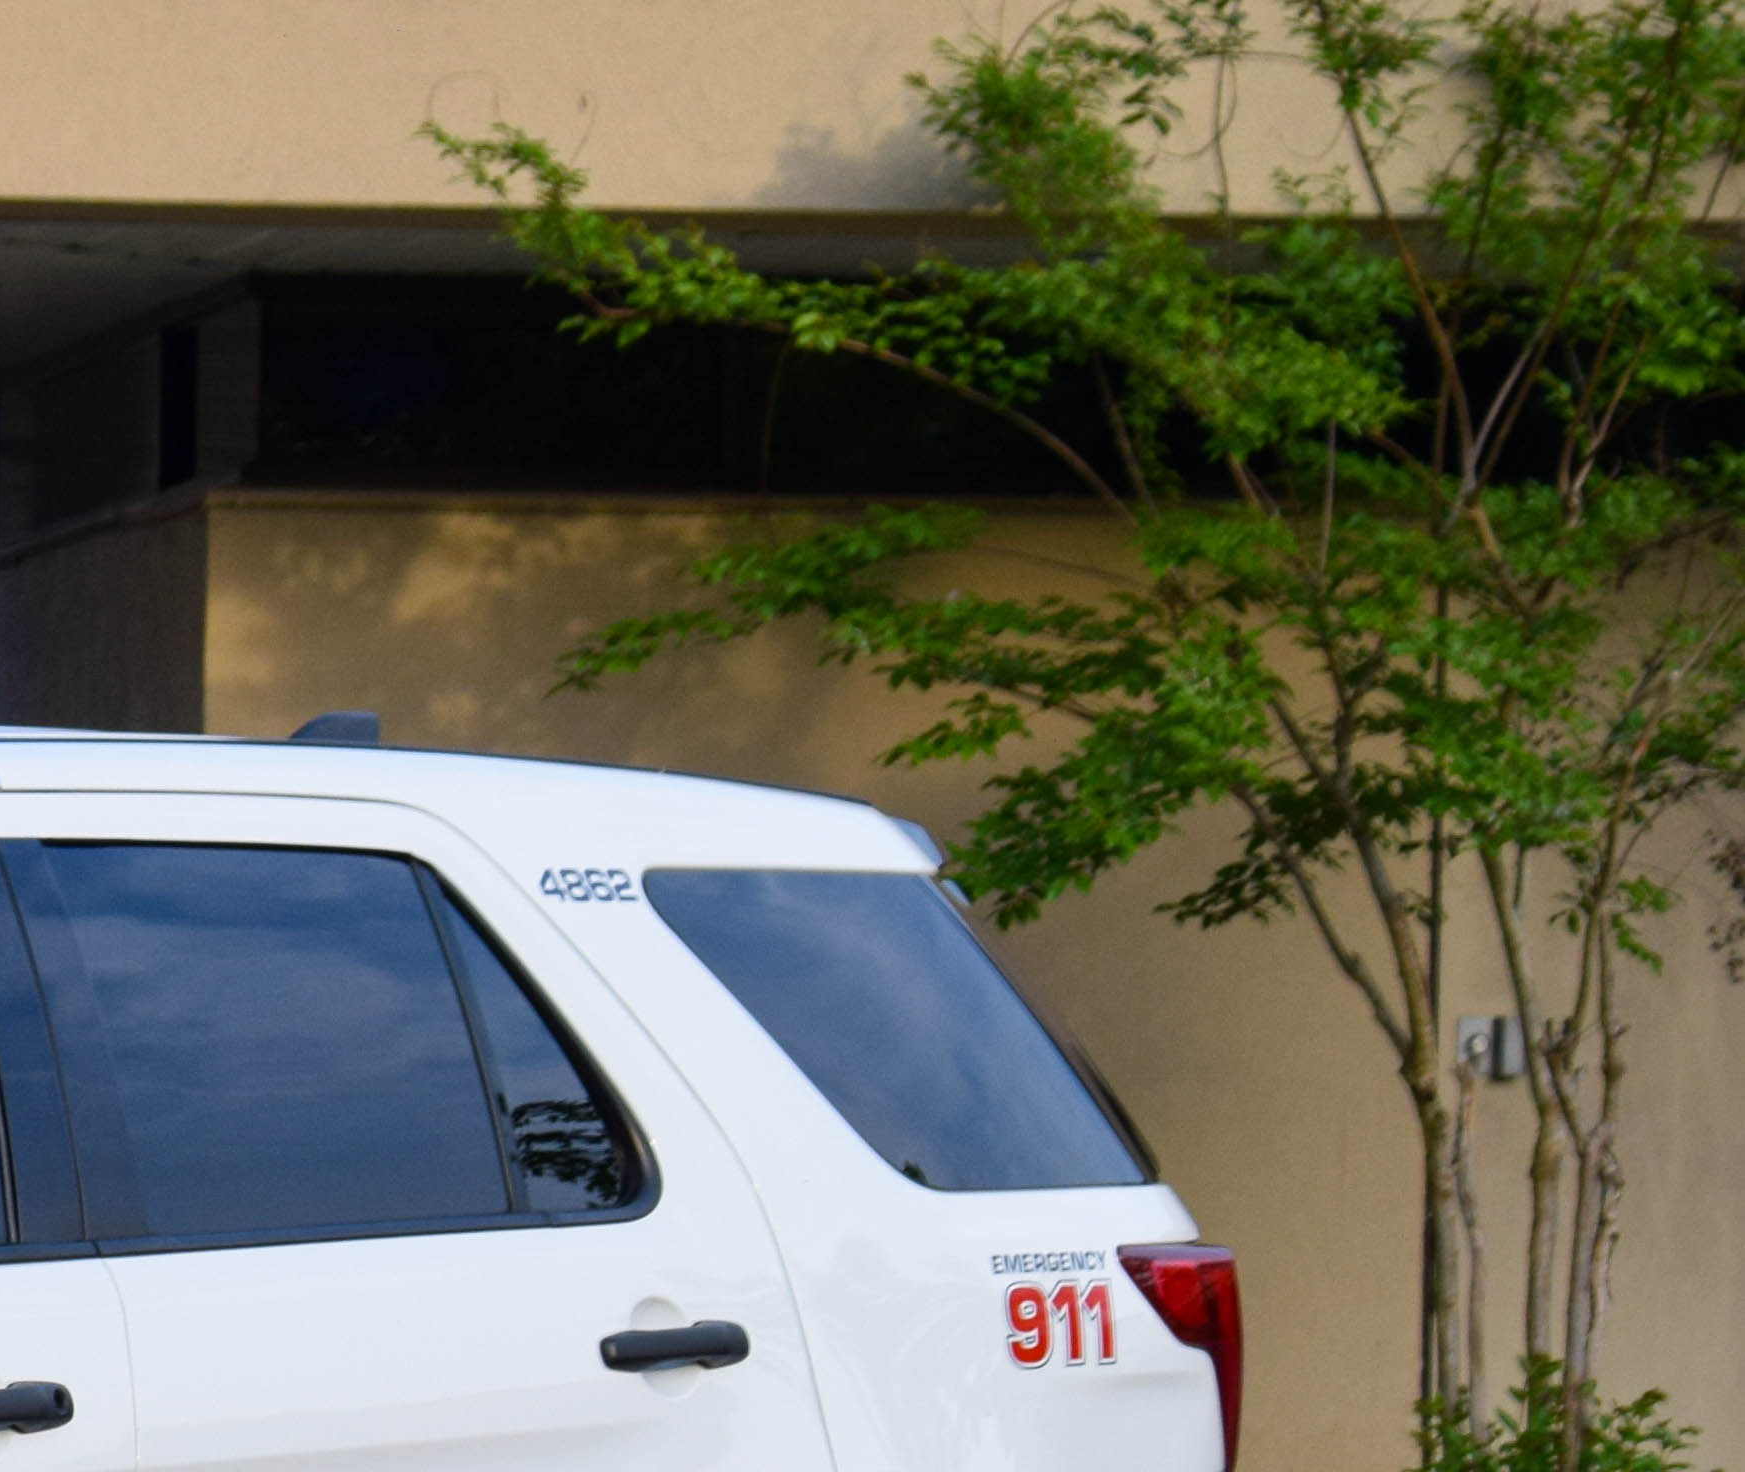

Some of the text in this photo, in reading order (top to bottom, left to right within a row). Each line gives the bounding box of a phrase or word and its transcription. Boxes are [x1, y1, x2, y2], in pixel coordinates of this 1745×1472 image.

[540, 868, 638, 901] 4862
[991, 1251, 1106, 1275] EMERGENCY
[1005, 1279, 1117, 1370] 911
